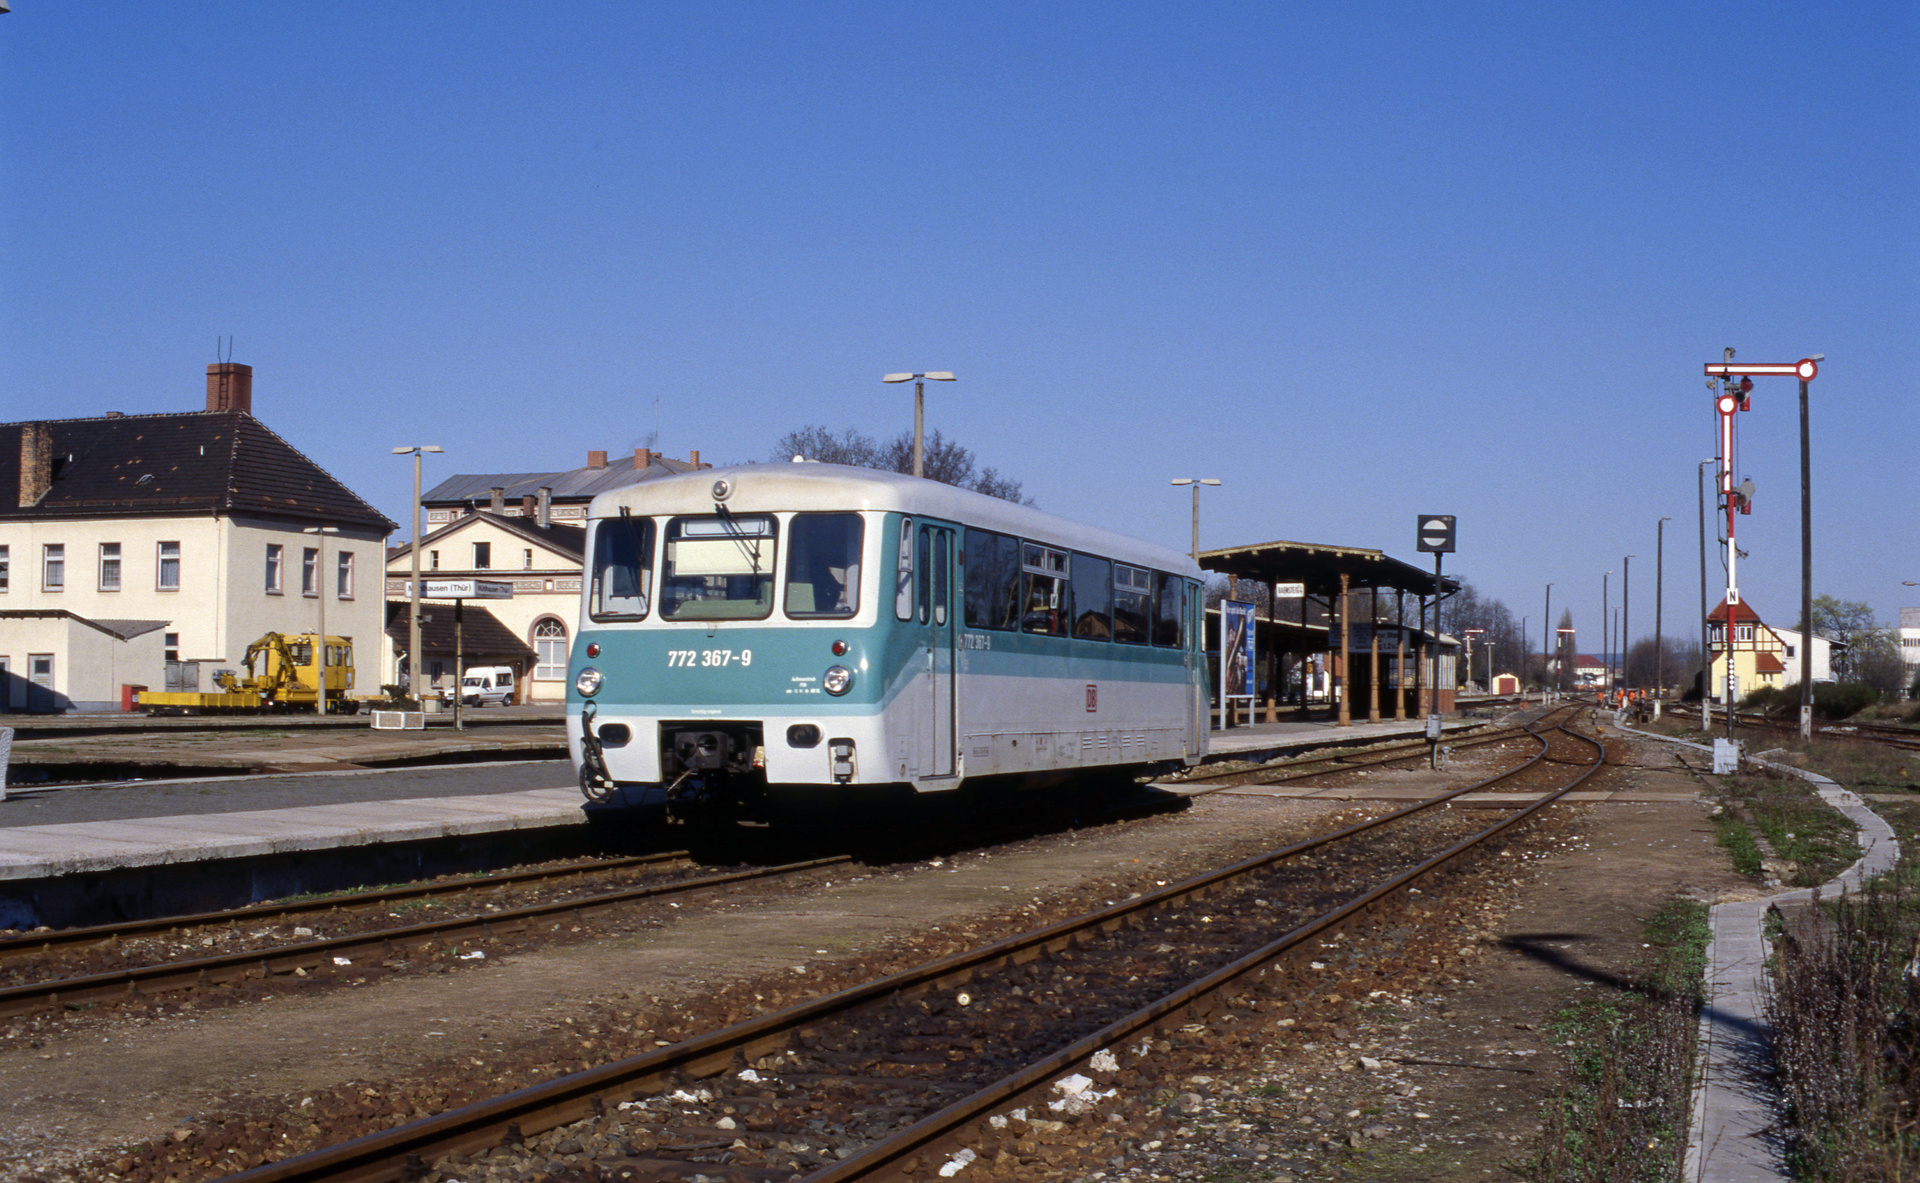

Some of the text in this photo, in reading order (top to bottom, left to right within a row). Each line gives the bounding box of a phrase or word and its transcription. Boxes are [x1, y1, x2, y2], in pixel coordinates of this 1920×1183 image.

[450, 584, 471, 592] (Thür)
[1729, 590, 1736, 602] N
[964, 633, 990, 650] 772 367-9
[668, 649, 752, 667] 772 367-9
[1086, 686, 1097, 710] DB
